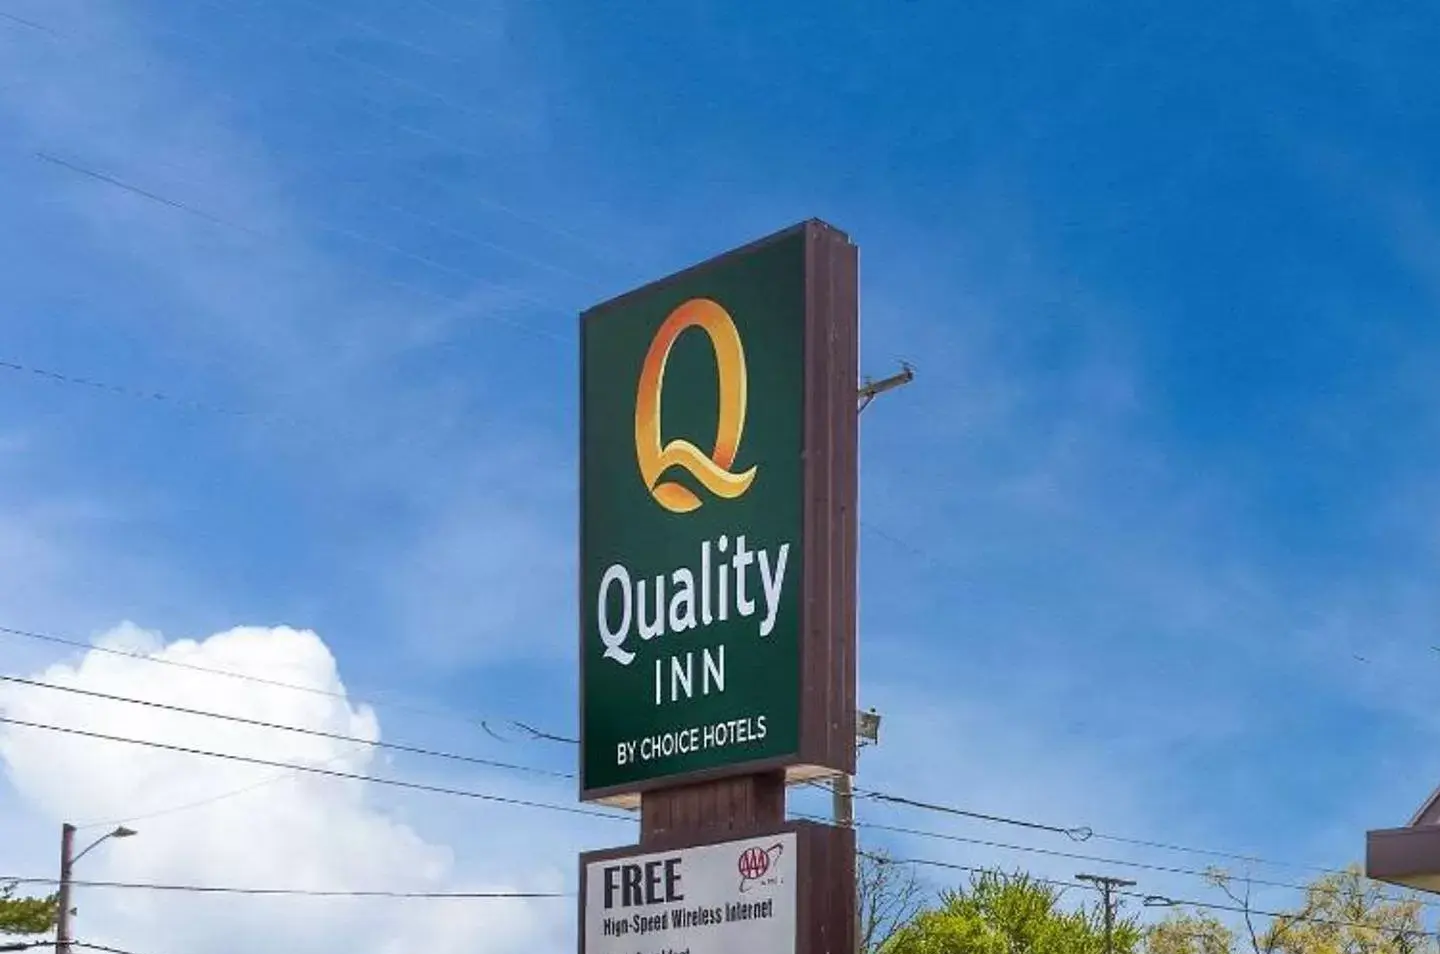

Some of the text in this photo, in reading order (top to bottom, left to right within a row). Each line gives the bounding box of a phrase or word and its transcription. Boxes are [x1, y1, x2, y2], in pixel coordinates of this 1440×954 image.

[635, 298, 757, 513] Q
[598, 534, 790, 666] Quality
[655, 644, 725, 706] INN
[617, 715, 767, 765] BY CHOICE HOTELS
[603, 857, 685, 910] FREE
[603, 898, 774, 937] High-Speed Wireless Internet
